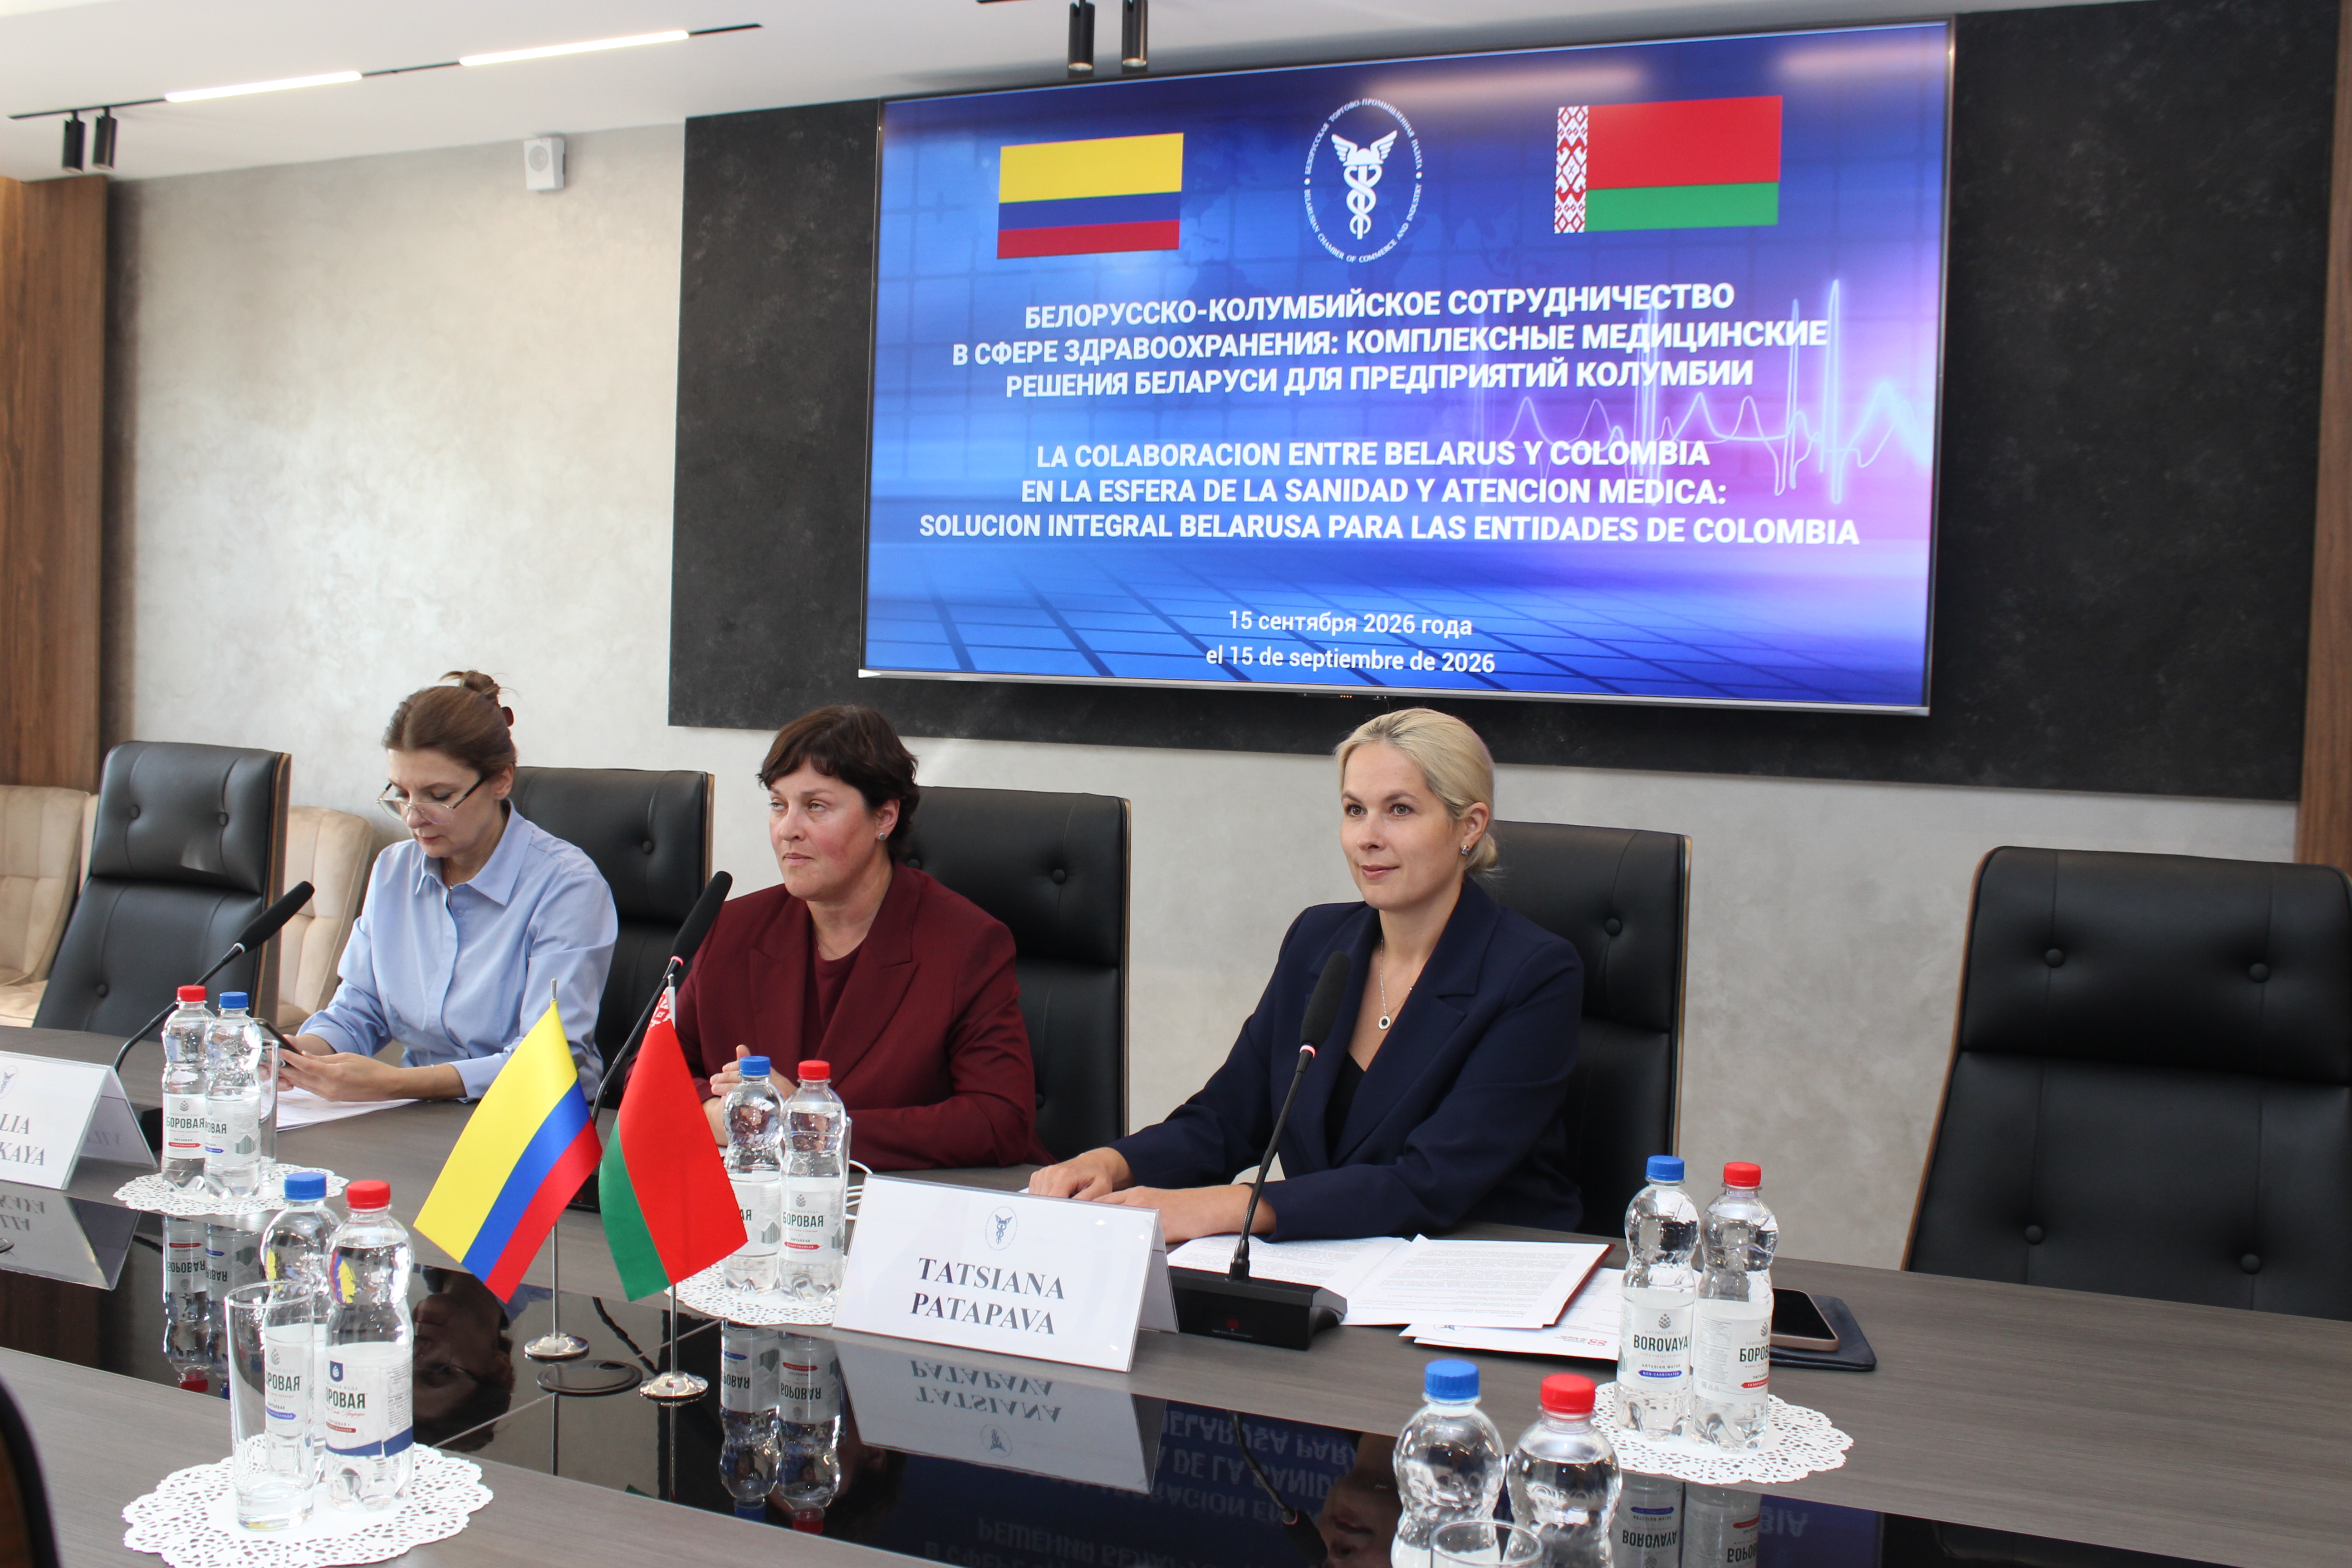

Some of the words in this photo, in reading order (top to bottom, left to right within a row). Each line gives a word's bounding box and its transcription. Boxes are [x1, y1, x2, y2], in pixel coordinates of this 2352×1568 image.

[1304, 189, 1320, 233] BELARUSIAN
[1318, 233, 1345, 261] CHAMBER
[1346, 255, 1357, 263] OF
[1358, 238, 1397, 264] COMMERCE
[1396, 222, 1409, 241] AND
[1406, 183, 1422, 222] INDUSTRY
[1026, 288, 1441, 328] БЕЛОРУССКО-КОЛУМБИЙСКОЕ
[1447, 283, 1735, 314] СОТРУДНИЧЕСТВО
[953, 344, 968, 365] В
[975, 340, 1058, 364] СФЕРЕ
[1064, 332, 1338, 366] ЗДРАВООХРАНЕНИЯ:
[1346, 325, 1575, 354] КОМПЛЕКСНЫЕ
[1583, 317, 1828, 353] МЕДИЦИНСКИЕ
[1007, 372, 1128, 397] РЕШЕНИЯ
[1135, 368, 1277, 394] БЕЛАРУСИ
[1284, 367, 1342, 396] ДЛЯ
[1350, 358, 1568, 394] ПРЕДПРИЯТИЙ
[1577, 360, 1753, 387] КОЛУМБИИ
[1037, 446, 1068, 467] LA
[1075, 442, 1280, 467] COLABORACION
[1289, 441, 1378, 465] ENTRE
[1385, 441, 1516, 465] BELARUS
[1523, 441, 1544, 465] Y
[1550, 441, 1710, 466] COLOMBIA
[1022, 480, 1054, 502] EN
[1061, 480, 1093, 502] LA
[1099, 479, 1196, 502] ESFERA
[1204, 479, 1237, 501] DE
[1244, 479, 1278, 501] LA
[1285, 478, 1409, 502] SANIDAD
[1416, 479, 1436, 502] Y
[1441, 479, 1591, 502] ATENCION
[1600, 479, 1727, 504] MEDICA:
[919, 514, 1041, 536] SOLUCION
[1048, 514, 1173, 537] INTEGRAL
[1180, 514, 1322, 538] BELARUSA
[1328, 515, 1404, 539] PARA
[1411, 515, 1466, 539] LAS
[1475, 516, 1638, 541] ENTIDADES
[1648, 518, 1686, 541] DE
[1694, 518, 1859, 544] COLOMBIA
[1229, 610, 1253, 630] 15
[1258, 611, 1357, 636] сентября
[1363, 613, 1416, 634] 2026
[1421, 618, 1473, 639] года
[1206, 645, 1223, 664] el
[1230, 646, 1254, 665] 15
[1259, 646, 1284, 666] de
[1289, 647, 1405, 672] septiembre
[1410, 650, 1437, 671] de
[1441, 652, 1496, 673] 2026
[0, 1113, 30, 1135] LIA
[166, 1117, 205, 1129] БОРОВАЯ
[205, 1121, 227, 1134] РОВАЯ
[0, 1142, 45, 1167] KAYA
[783, 1211, 824, 1228] БОРОВАЯ
[918, 1257, 1065, 1300] TATSIANA
[909, 1292, 1055, 1335] PATAPAVA
[1633, 1333, 1689, 1352] BOROVAYA
[1739, 1344, 1769, 1362] БОРОВ
